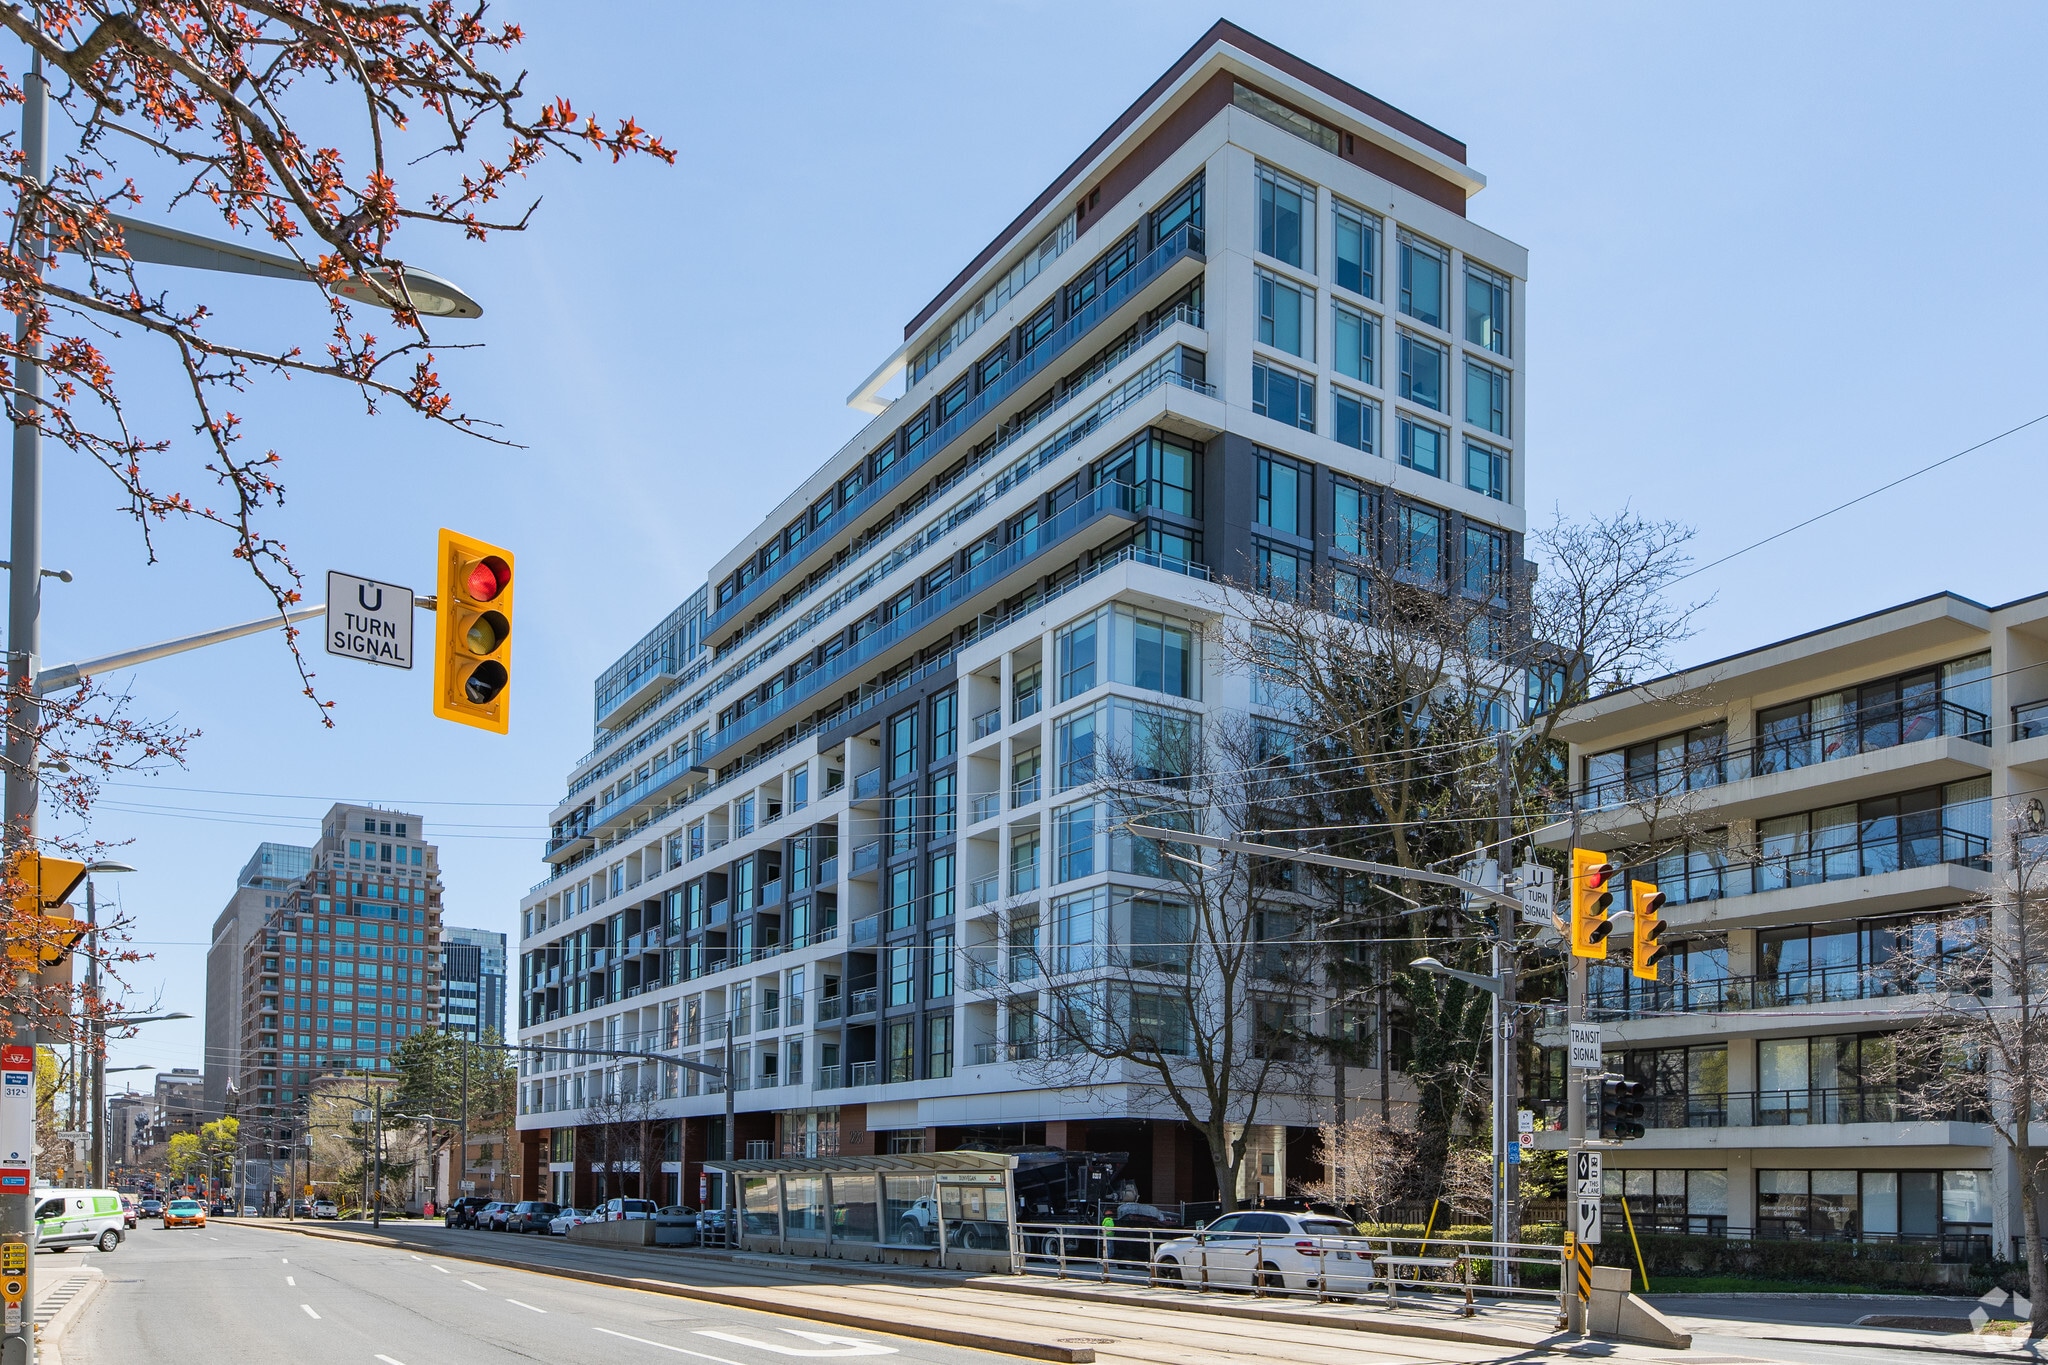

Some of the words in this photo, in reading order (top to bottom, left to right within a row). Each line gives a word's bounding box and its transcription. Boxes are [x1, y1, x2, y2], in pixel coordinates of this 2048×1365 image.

[358, 584, 382, 611] U
[344, 612, 396, 639] TURN
[334, 631, 405, 661] SIGNAL
[1532, 870, 1543, 887] U
[1528, 890, 1548, 904] TURN
[1525, 905, 1550, 919] SIGNAL
[1571, 1030, 1600, 1044] TRANSIT
[1573, 1047, 1598, 1062] SIGNAL
[6, 1088, 21, 1096] 312
